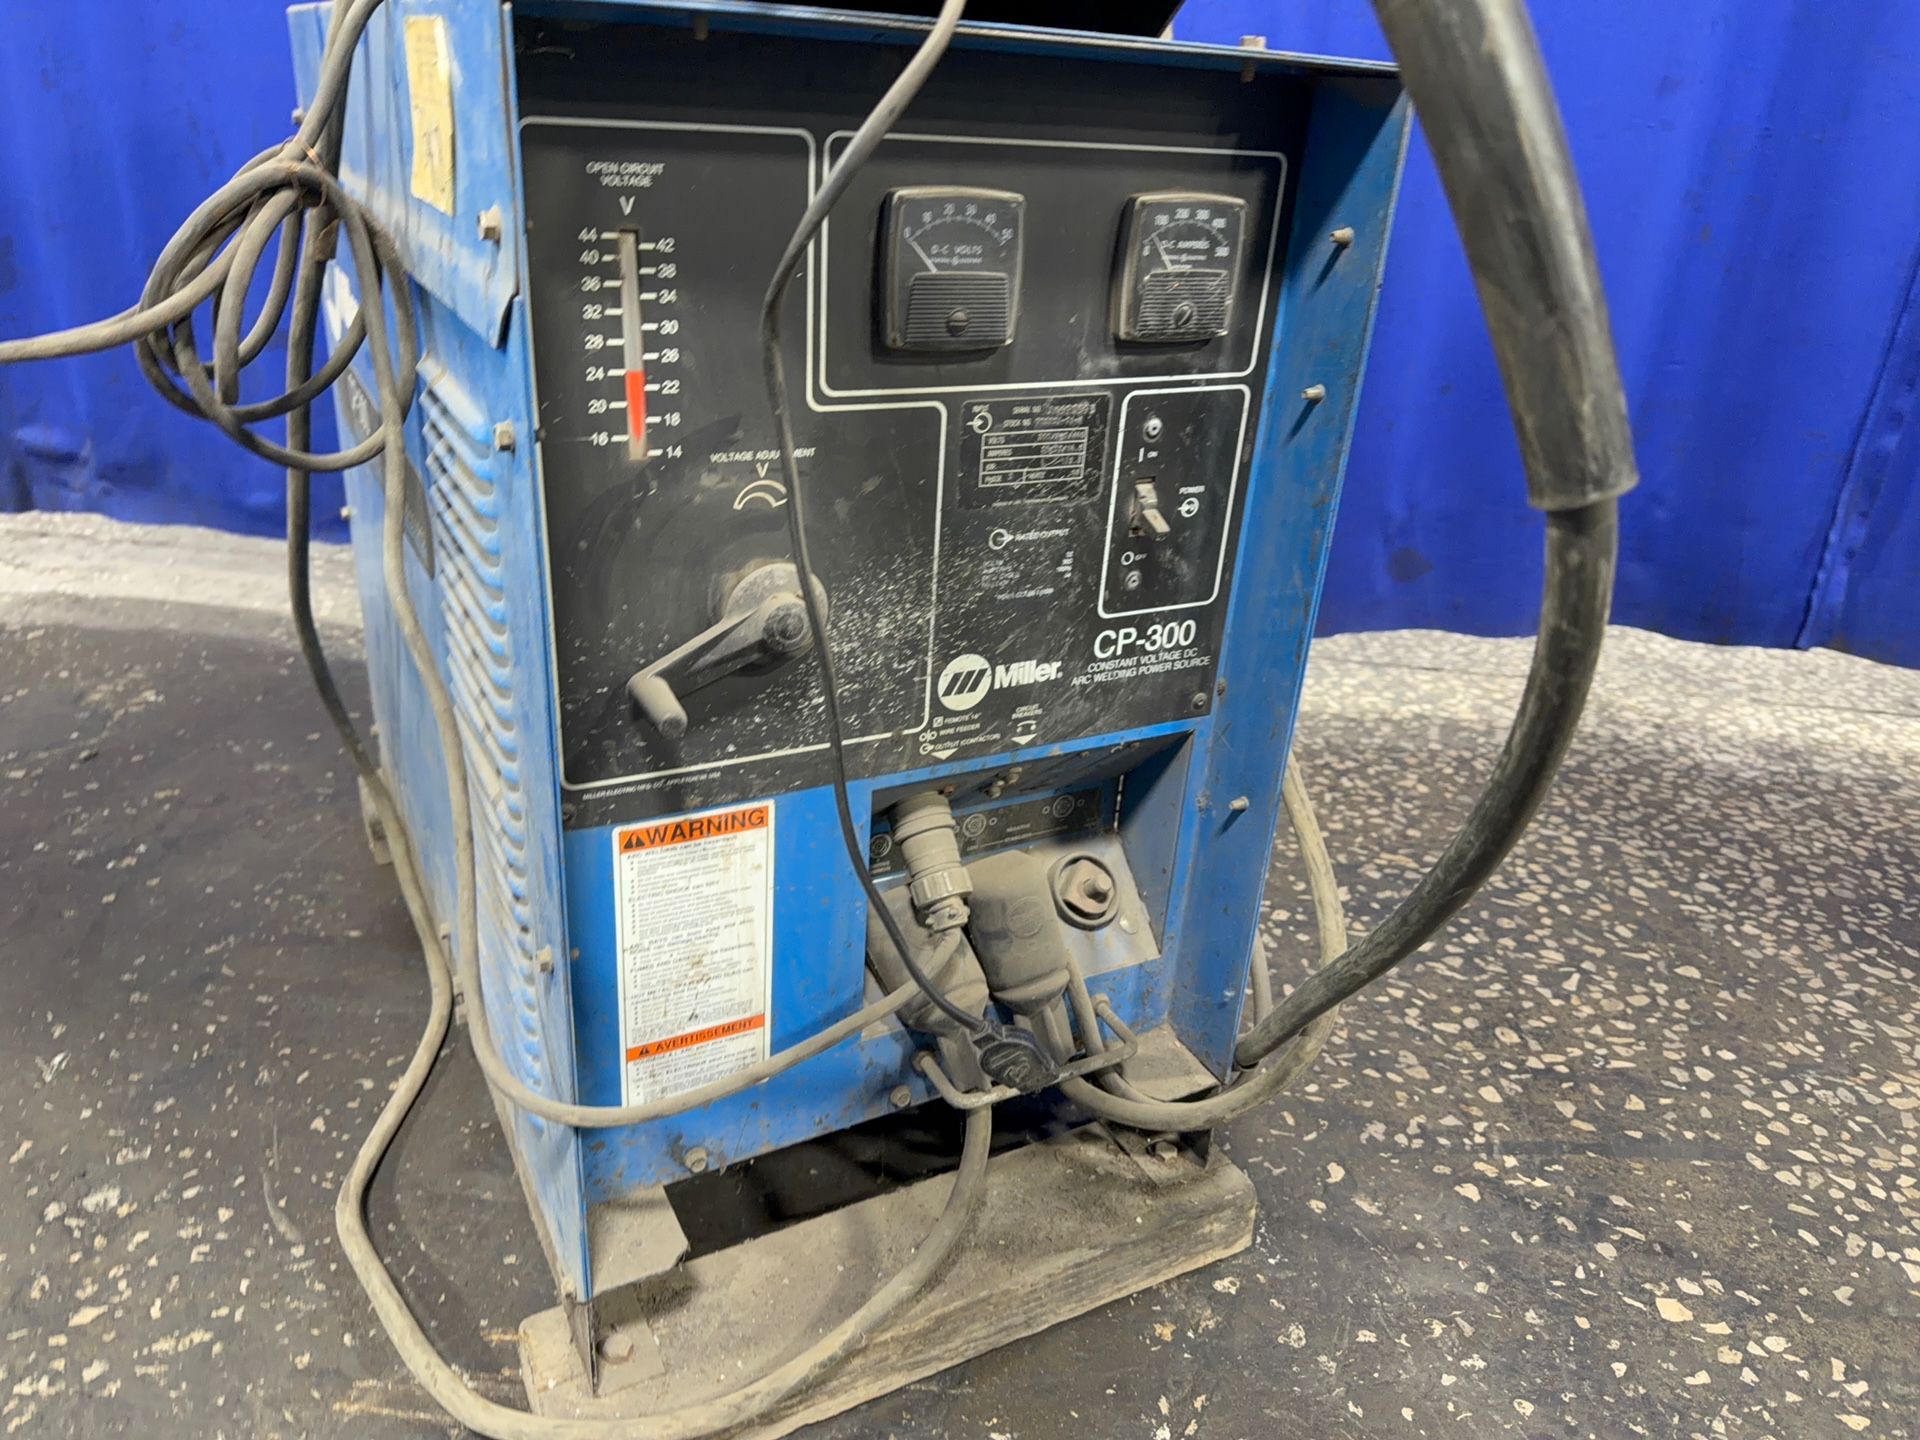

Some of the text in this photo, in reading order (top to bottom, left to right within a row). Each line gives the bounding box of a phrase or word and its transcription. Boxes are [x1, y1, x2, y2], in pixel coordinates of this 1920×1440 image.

[586, 161, 665, 175] OPEN CIRCUIT
[600, 174, 653, 188] VOLTAGE
[619, 195, 635, 216] V
[578, 227, 598, 243] 44
[655, 237, 675, 253] 42
[579, 249, 599, 265] 40
[657, 263, 677, 279] 38
[581, 276, 601, 292] 36
[659, 288, 678, 304] 34
[582, 303, 602, 320] 32
[660, 319, 679, 335] 30
[584, 334, 604, 350] 28
[661, 348, 680, 363] 26
[585, 366, 605, 381] 24
[661, 380, 680, 395] 22
[588, 399, 608, 414] 20
[664, 413, 681, 427] 18
[591, 431, 609, 446] 16
[665, 445, 683, 459] 14
[709, 447, 816, 463] VOLTAGE ADJUMENT
[756, 461, 769, 479] V
[1179, 485, 1205, 494] POWER
[1093, 619, 1197, 659] CP-300
[1087, 647, 1198, 673] CONSTANT VOLTAGE DC
[1071, 656, 1211, 687] ARC WELDING POWER SOURCE
[956, 723, 980, 733] FEEDER
[646, 809, 765, 845] WARNING
[656, 1021, 753, 1051] AVERTISSEMENT
